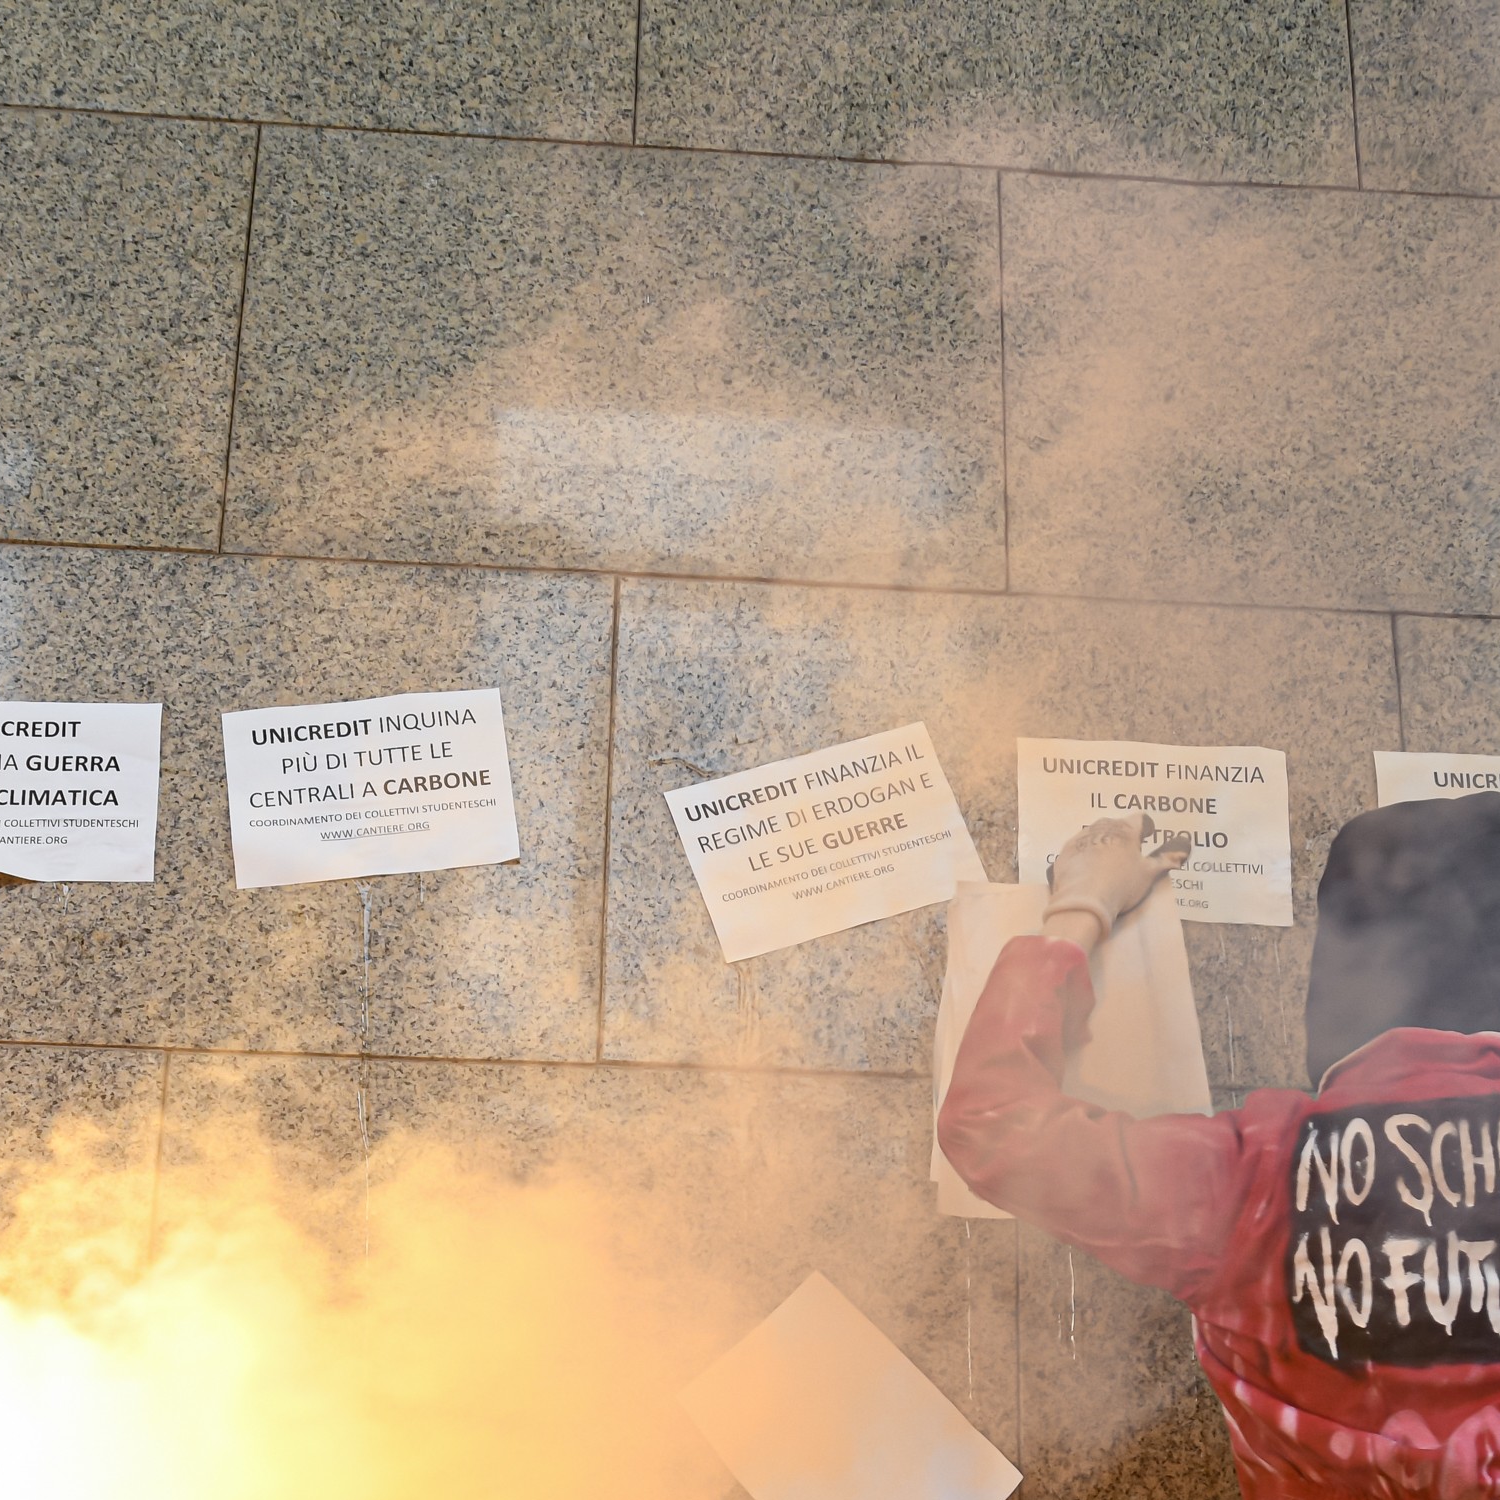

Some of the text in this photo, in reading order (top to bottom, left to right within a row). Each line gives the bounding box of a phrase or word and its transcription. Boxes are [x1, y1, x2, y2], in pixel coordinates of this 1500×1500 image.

[252, 708, 477, 746] UNICREDIT INQUINA
[26, 755, 120, 772] GUERRA
[281, 741, 453, 775] PIÙ DI TUTTE LE
[1042, 757, 1265, 783] UNICREDIT FINANZIA
[249, 769, 491, 809] CENTRALI A CARBONE
[685, 744, 924, 822] UNICREDIT FINANZIA IL
[249, 798, 496, 828] COORDINAMENTO DEI COLLETTIVI STUDENTESCHI
[697, 772, 934, 854] REGIME DI ERDOGAN E
[1091, 792, 1217, 815] IL CARBONE
[4, 818, 60, 828] COLLETTIVI
[63, 818, 139, 828] STUDENTESCHI
[748, 812, 908, 872] LE SUE GUERRE
[722, 830, 952, 903] COORDINAMENTO DEI COLLETTIVI STUDENTESCHI
[1193, 861, 1264, 874] COLLETTIVI
[1295, 1117, 1375, 1225] NO
[1293, 1226, 1372, 1360] NO
